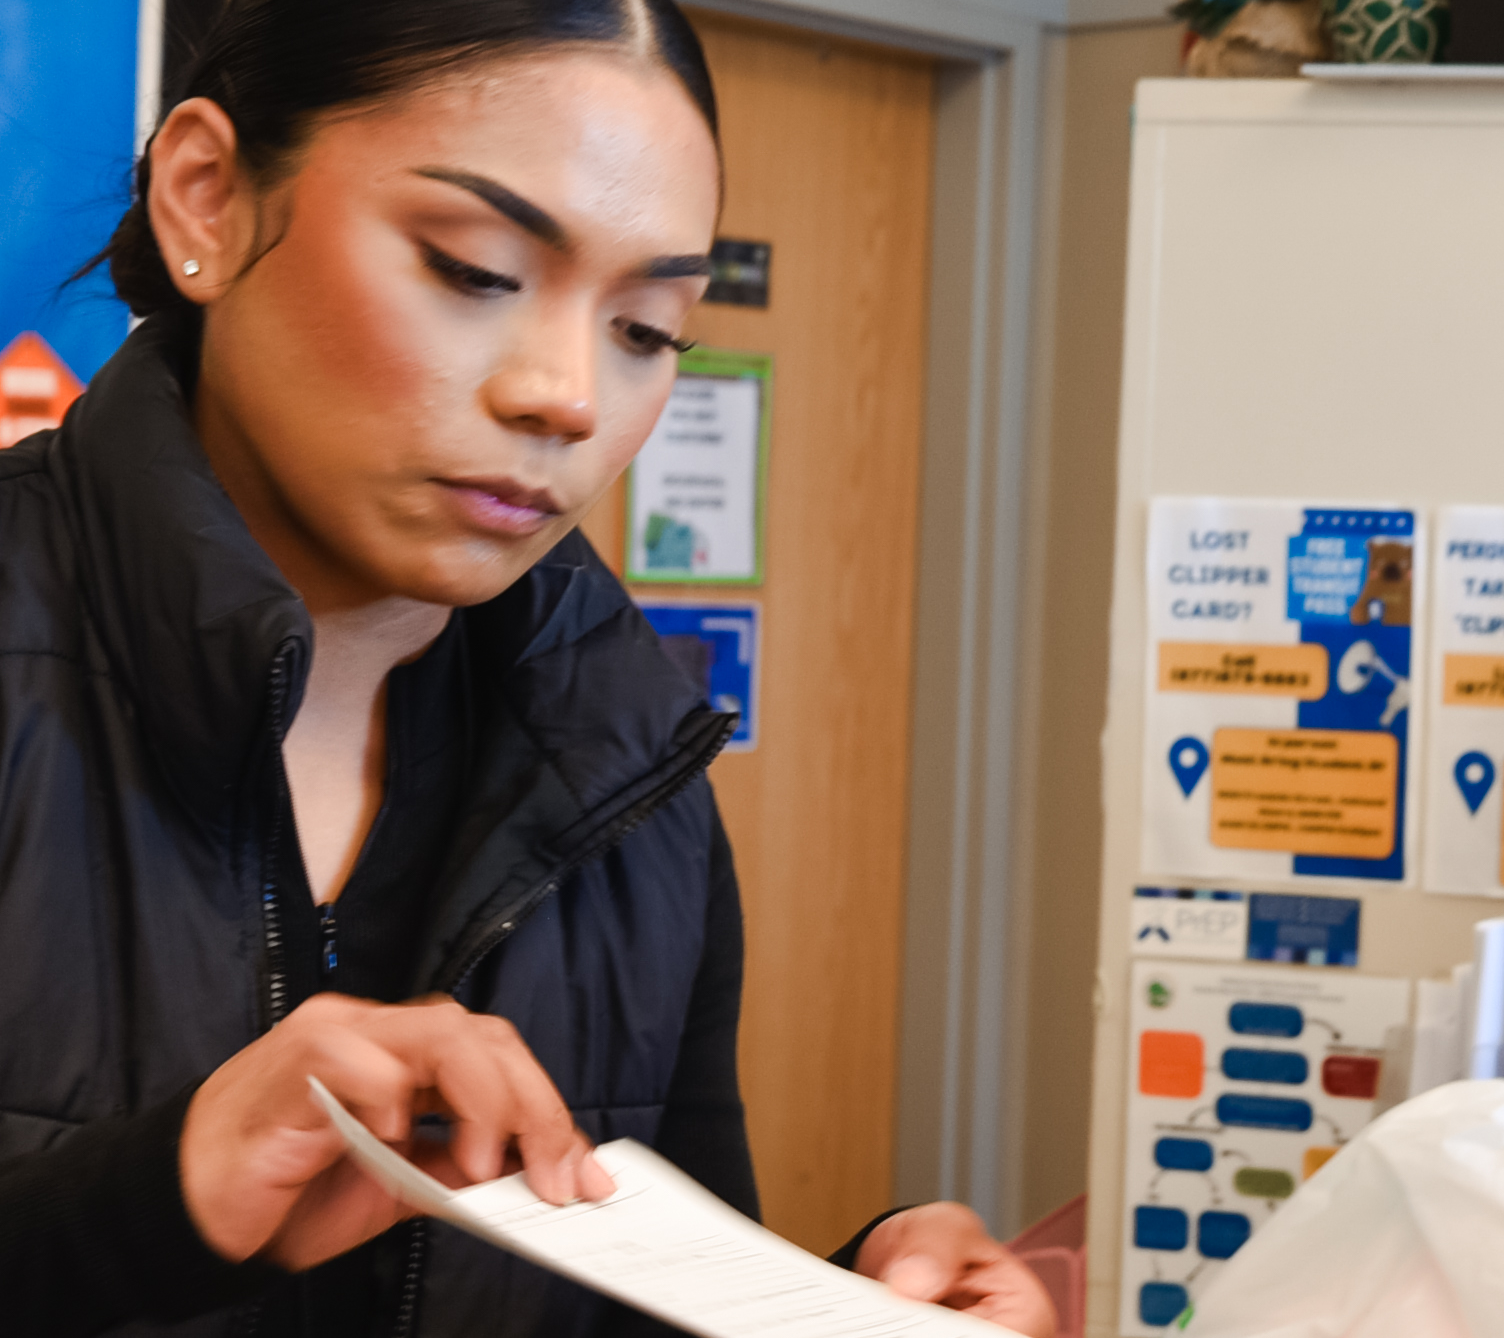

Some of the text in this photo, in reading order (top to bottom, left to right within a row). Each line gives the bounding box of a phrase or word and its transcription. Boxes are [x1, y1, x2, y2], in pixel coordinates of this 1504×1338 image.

[1190, 531, 1250, 551] LOST
[1168, 564, 1270, 586] CLIPPER
[1171, 598, 1254, 621] CARD?
